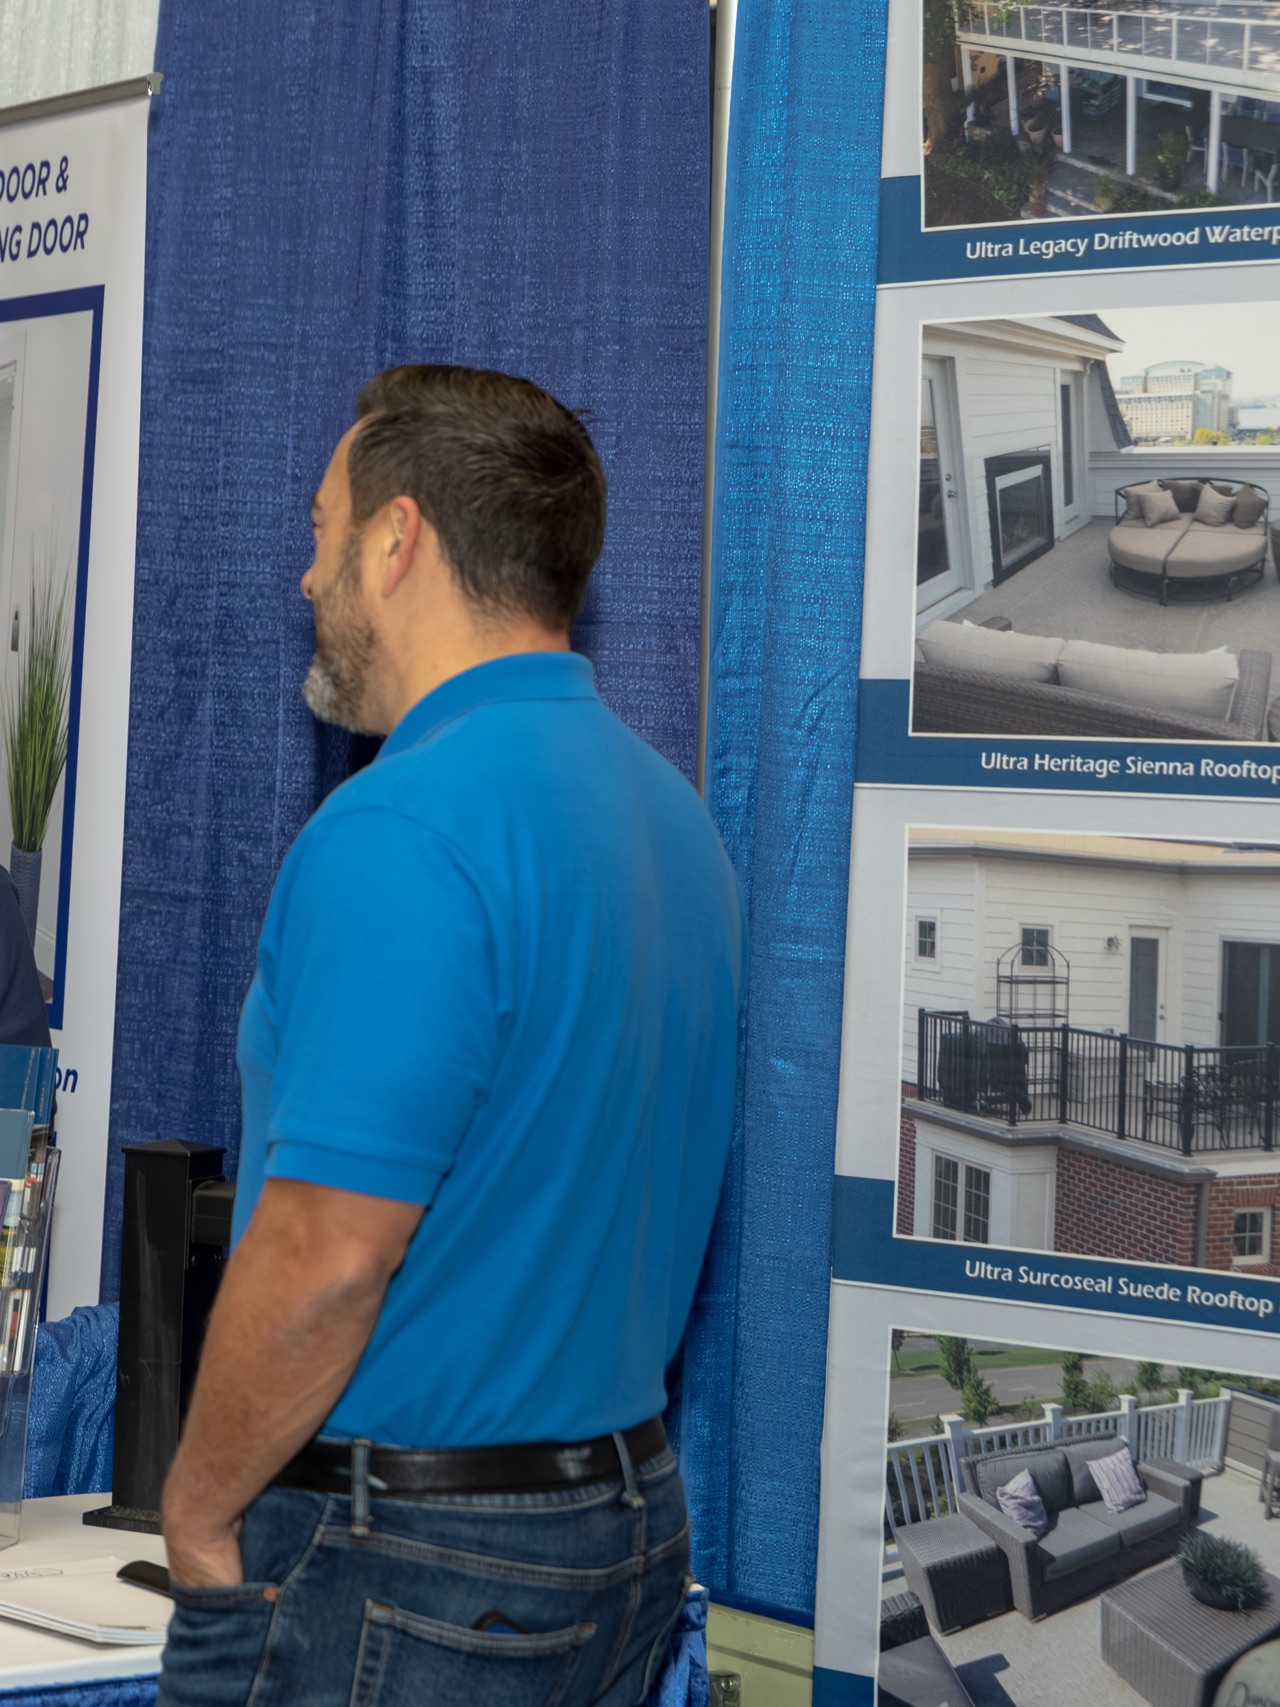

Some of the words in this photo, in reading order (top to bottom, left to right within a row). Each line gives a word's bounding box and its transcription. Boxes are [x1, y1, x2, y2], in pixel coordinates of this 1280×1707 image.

[55, 155, 69, 193] &
[26, 213, 90, 260] DOOR
[965, 242, 1013, 259] Ultra
[1019, 237, 1088, 259] Legacy
[1093, 227, 1200, 251] Driftwood
[981, 752, 1029, 770] Ultra
[1034, 754, 1121, 778] Heritage
[1125, 756, 1194, 777] Sienna
[1200, 758, 1280, 784] Rooftop
[965, 1259, 1013, 1282] Ultra
[1018, 1266, 1113, 1294] Surcoseal
[1117, 1277, 1182, 1302] Suede
[1186, 1285, 1274, 1318] Rooftop
